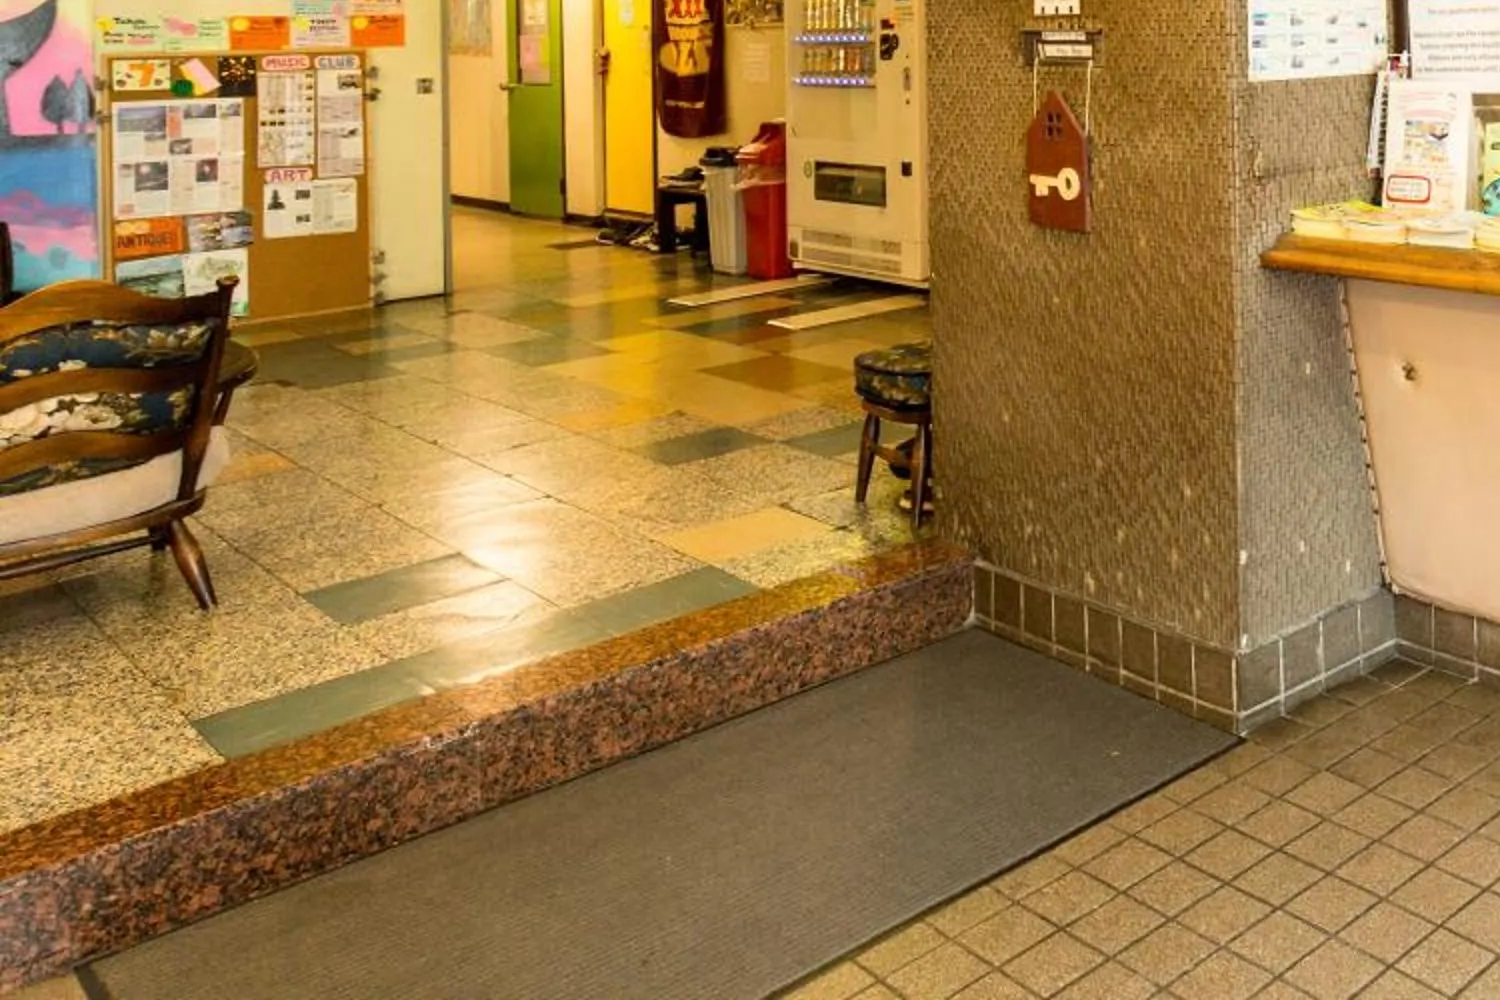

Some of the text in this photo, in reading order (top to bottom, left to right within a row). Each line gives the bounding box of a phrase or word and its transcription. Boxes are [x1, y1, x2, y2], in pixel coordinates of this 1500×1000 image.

[266, 56, 308, 70] MUSIC
[317, 56, 356, 70] CLUB
[270, 168, 308, 182] ART
